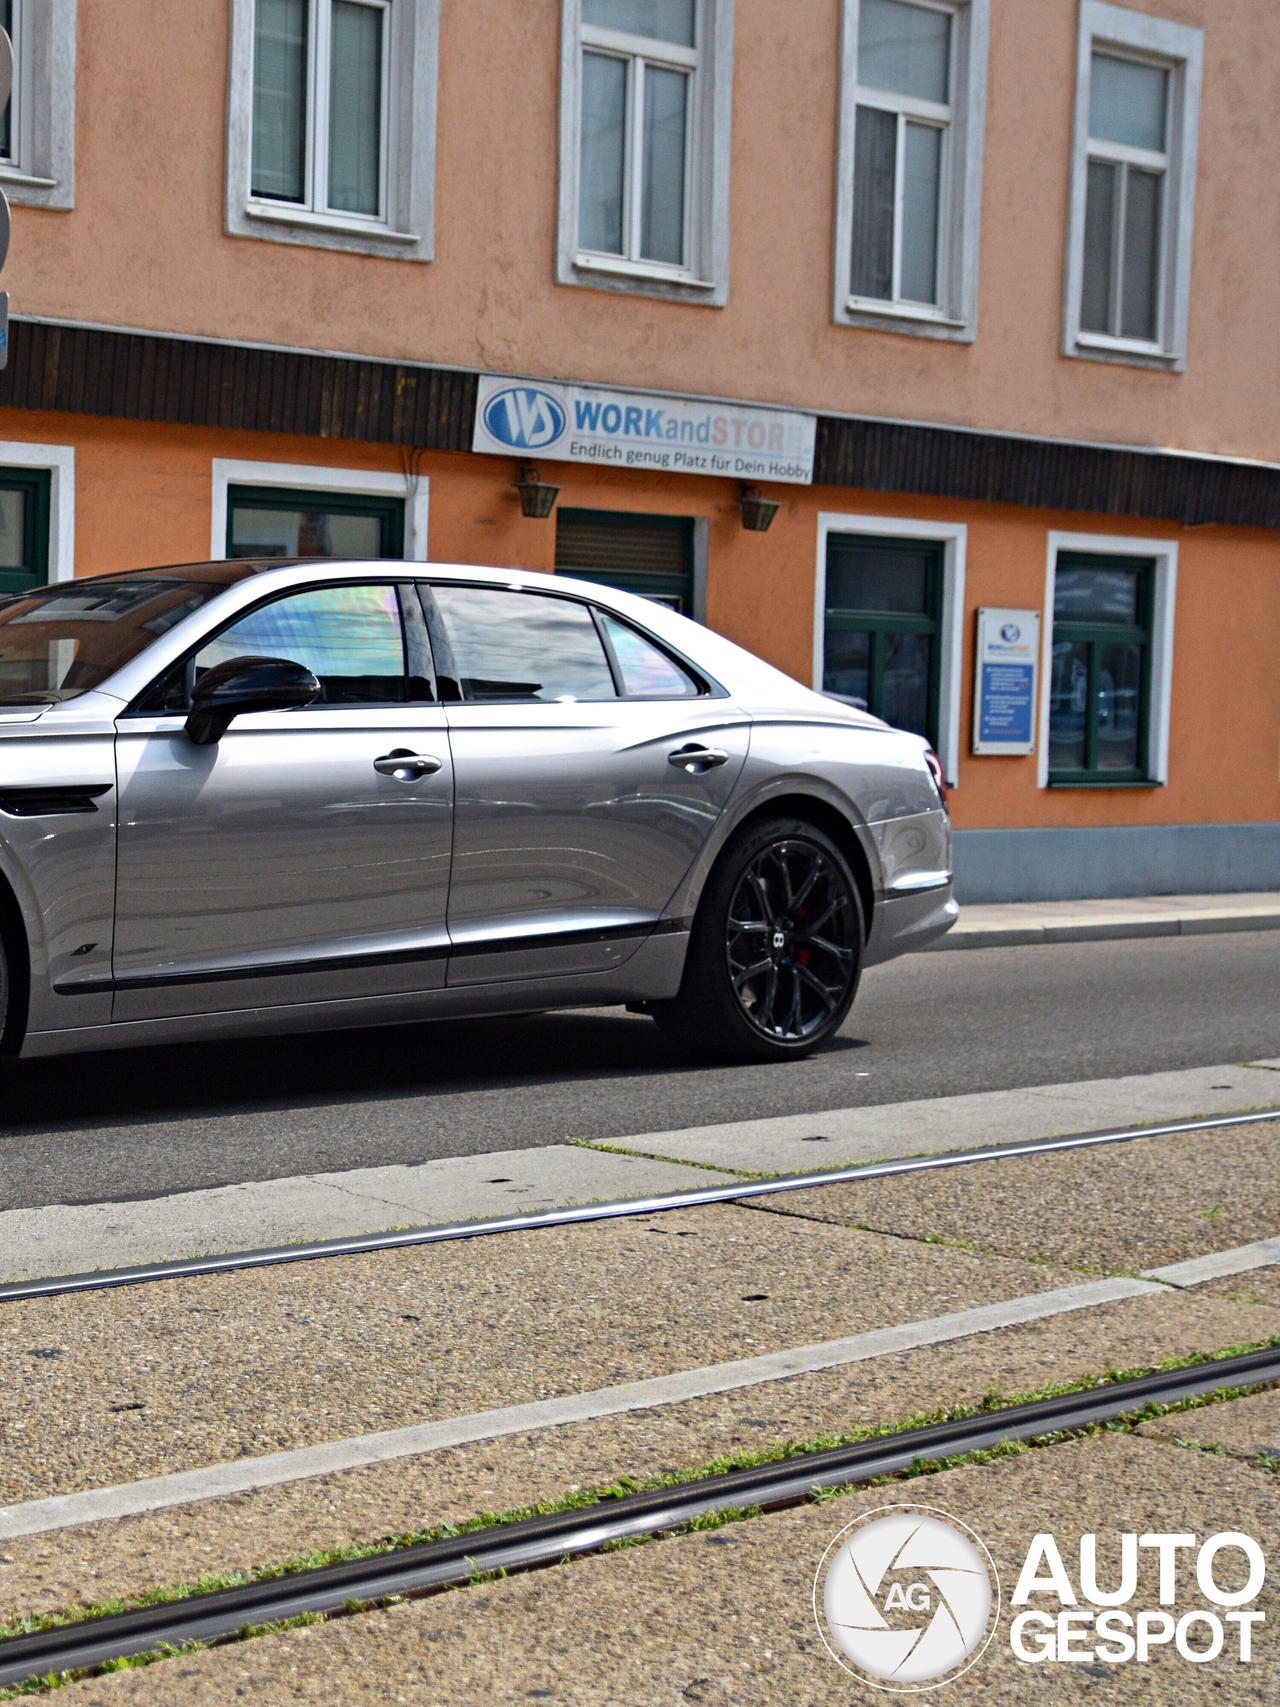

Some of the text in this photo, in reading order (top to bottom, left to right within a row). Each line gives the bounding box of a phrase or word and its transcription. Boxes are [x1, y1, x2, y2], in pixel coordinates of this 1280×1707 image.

[570, 441, 811, 482] Endlich genug Platz für Dein Hobby
